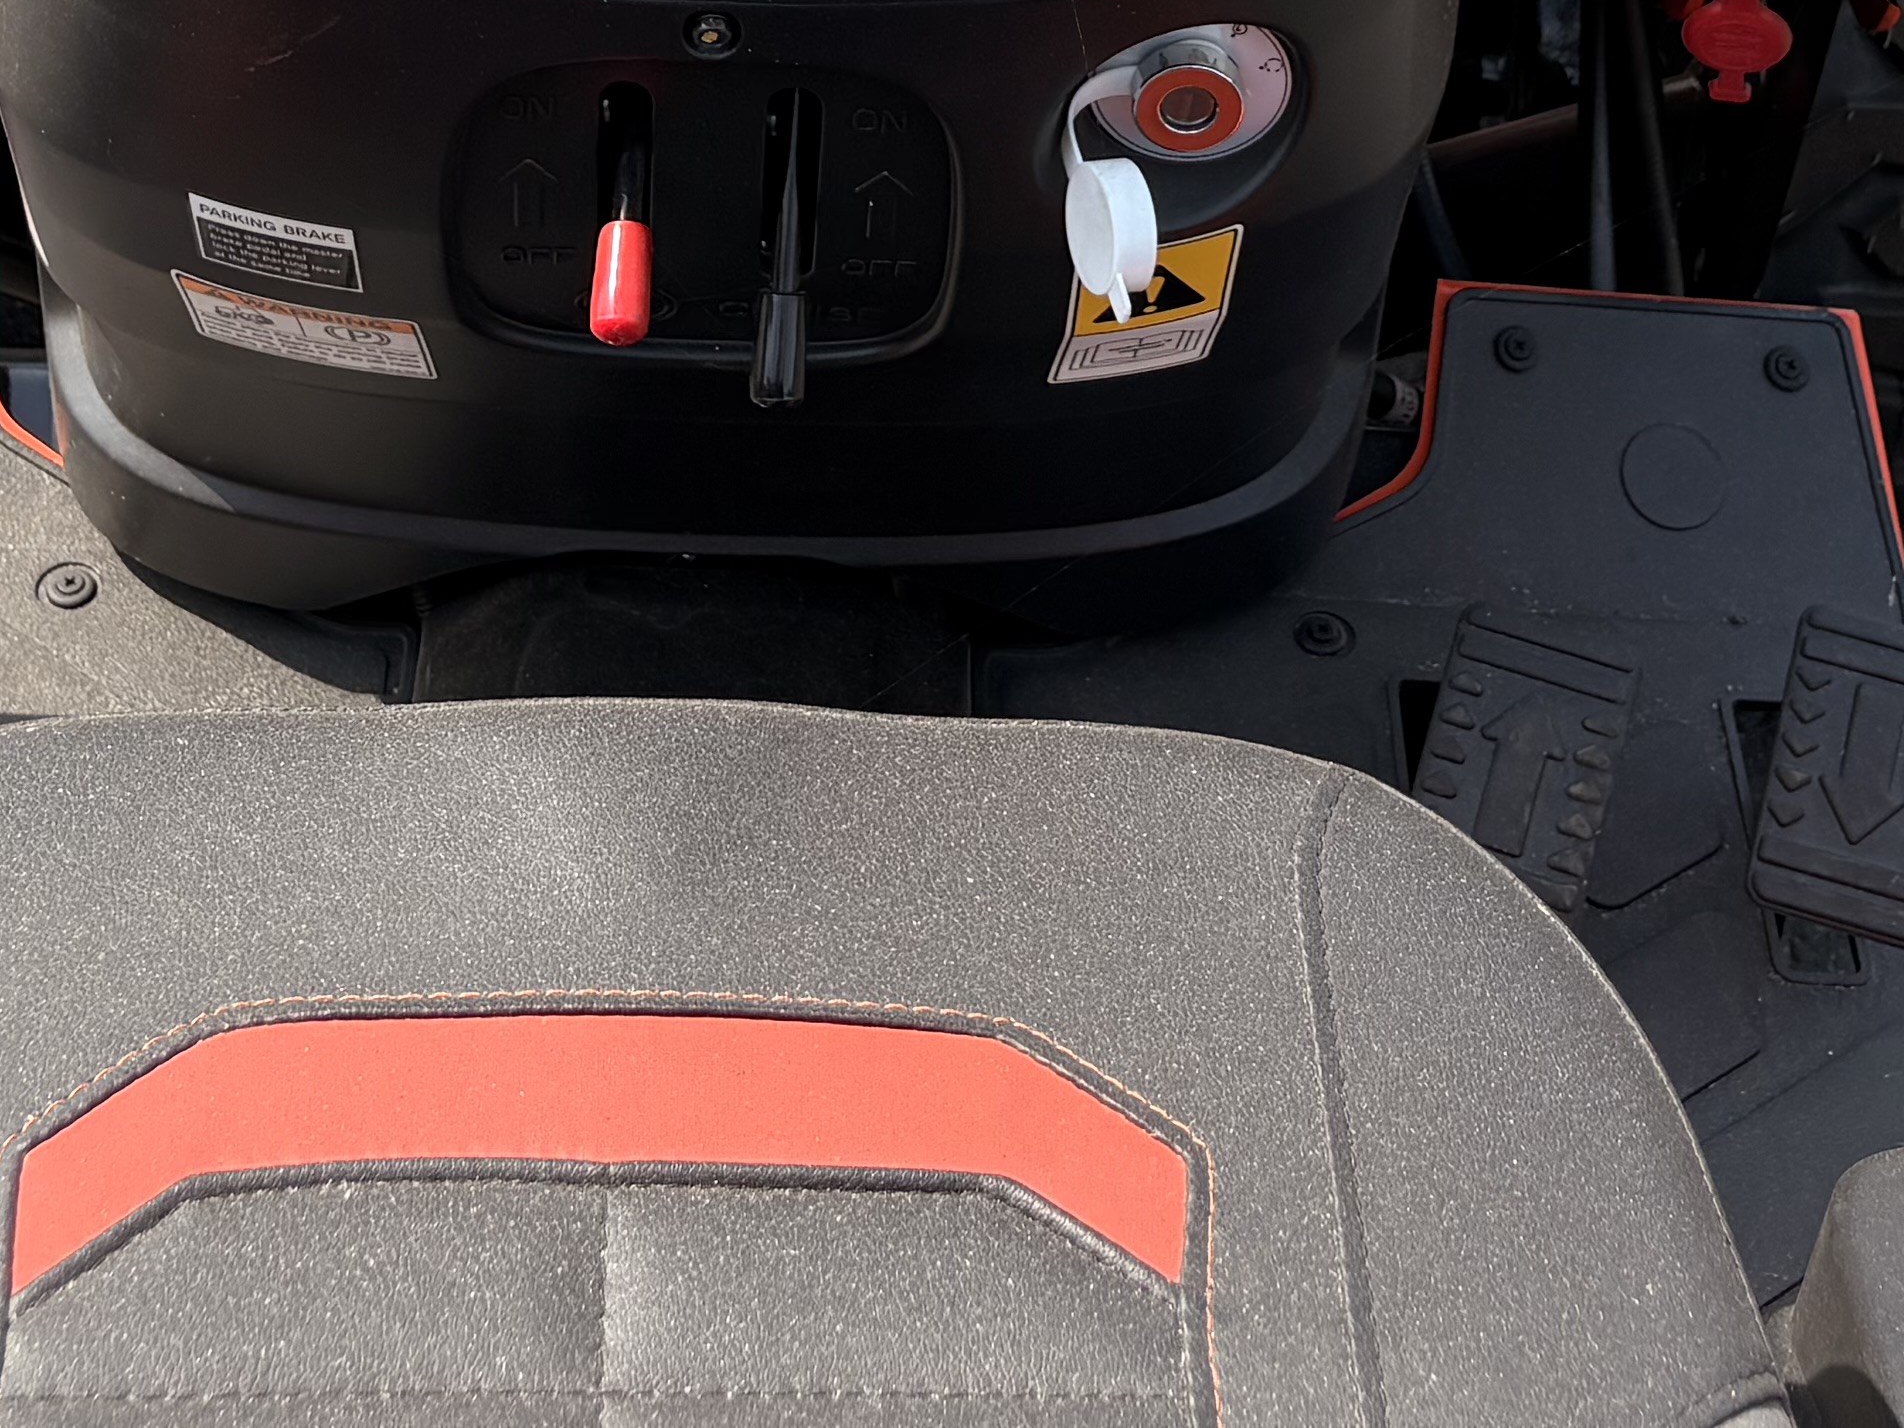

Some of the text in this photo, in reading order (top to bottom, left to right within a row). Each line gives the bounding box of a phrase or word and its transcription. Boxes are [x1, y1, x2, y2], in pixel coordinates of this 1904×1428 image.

[502, 95, 554, 120] ON
[851, 107, 908, 134] ON
[199, 203, 346, 244] PARKING BRAKE
[841, 258, 918, 277] OFF
[237, 296, 392, 331] WARNING
